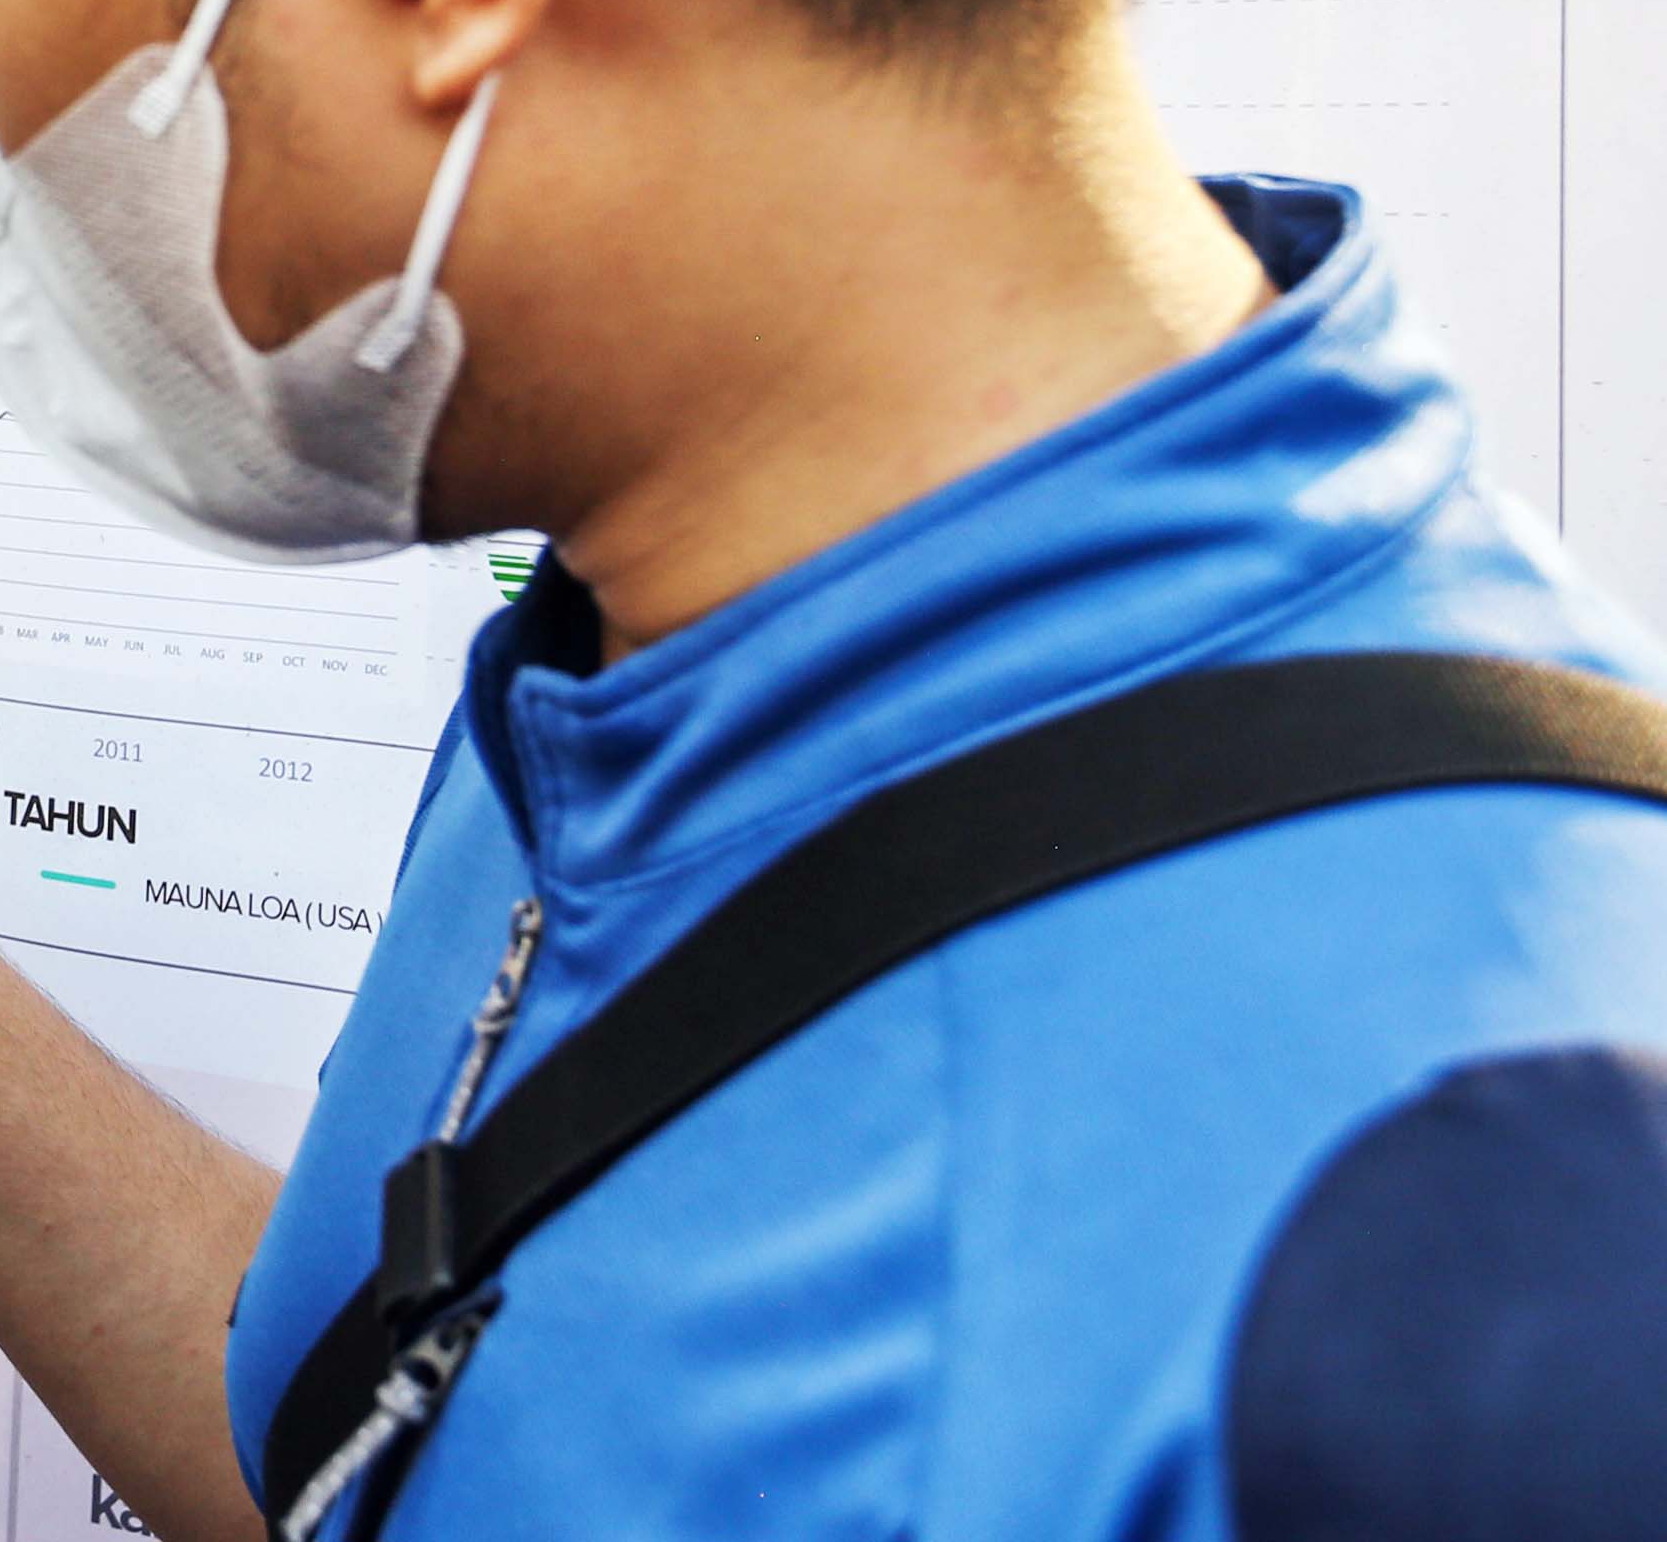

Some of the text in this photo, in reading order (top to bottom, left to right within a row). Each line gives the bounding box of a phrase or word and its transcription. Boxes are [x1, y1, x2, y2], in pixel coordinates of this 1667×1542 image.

[17, 627, 38, 639] MAR
[51, 632, 71, 643] APR
[85, 636, 109, 648] MAY
[123, 640, 145, 652] JUN
[163, 644, 182, 656] JUL
[200, 647, 225, 660] AUG
[243, 651, 263, 663] SEP
[282, 656, 306, 667] OCT
[322, 659, 348, 672] NOV
[365, 664, 388, 676] DEC
[93, 738, 144, 762] 2011
[259, 758, 314, 782] 2012
[4, 790, 137, 844] TAHUN
[145, 879, 243, 915] MAUNA
[249, 893, 301, 924] LOA
